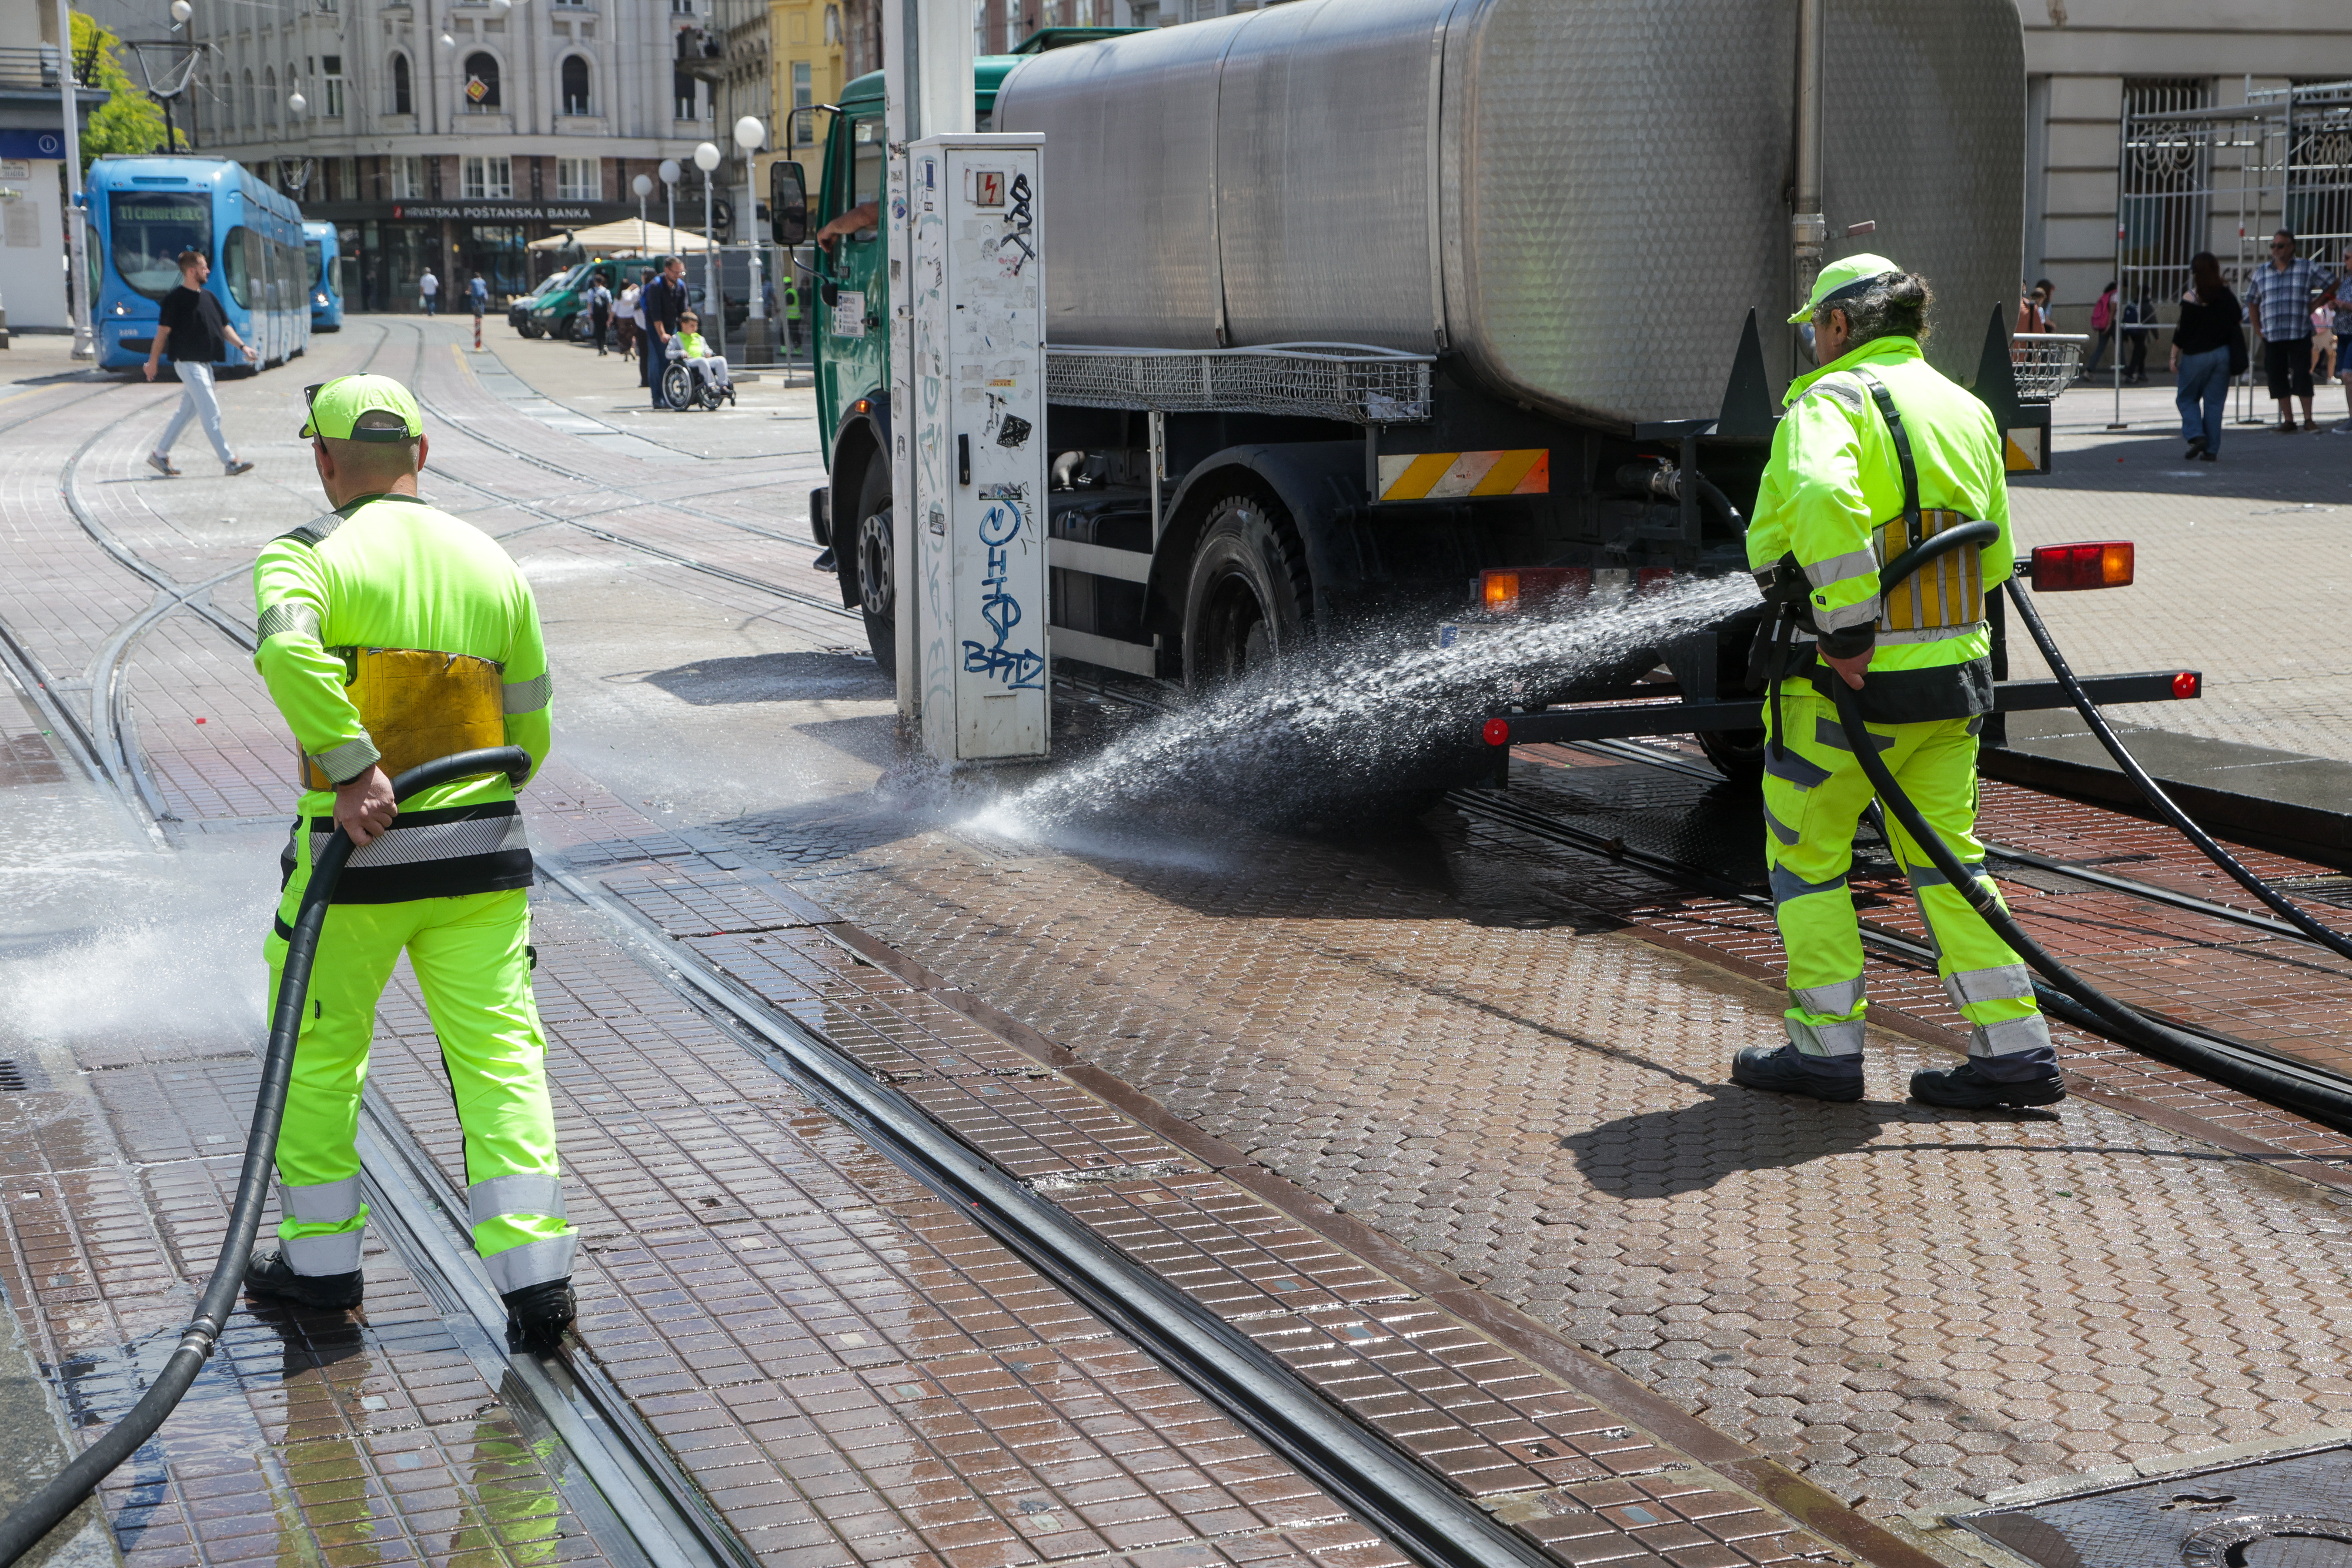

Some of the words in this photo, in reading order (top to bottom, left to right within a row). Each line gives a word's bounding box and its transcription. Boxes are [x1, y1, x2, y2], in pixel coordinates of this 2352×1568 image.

[405, 207, 460, 219] HRVATSKA
[463, 206, 543, 219] POŠTANSKA
[547, 208, 591, 219] BANKA
